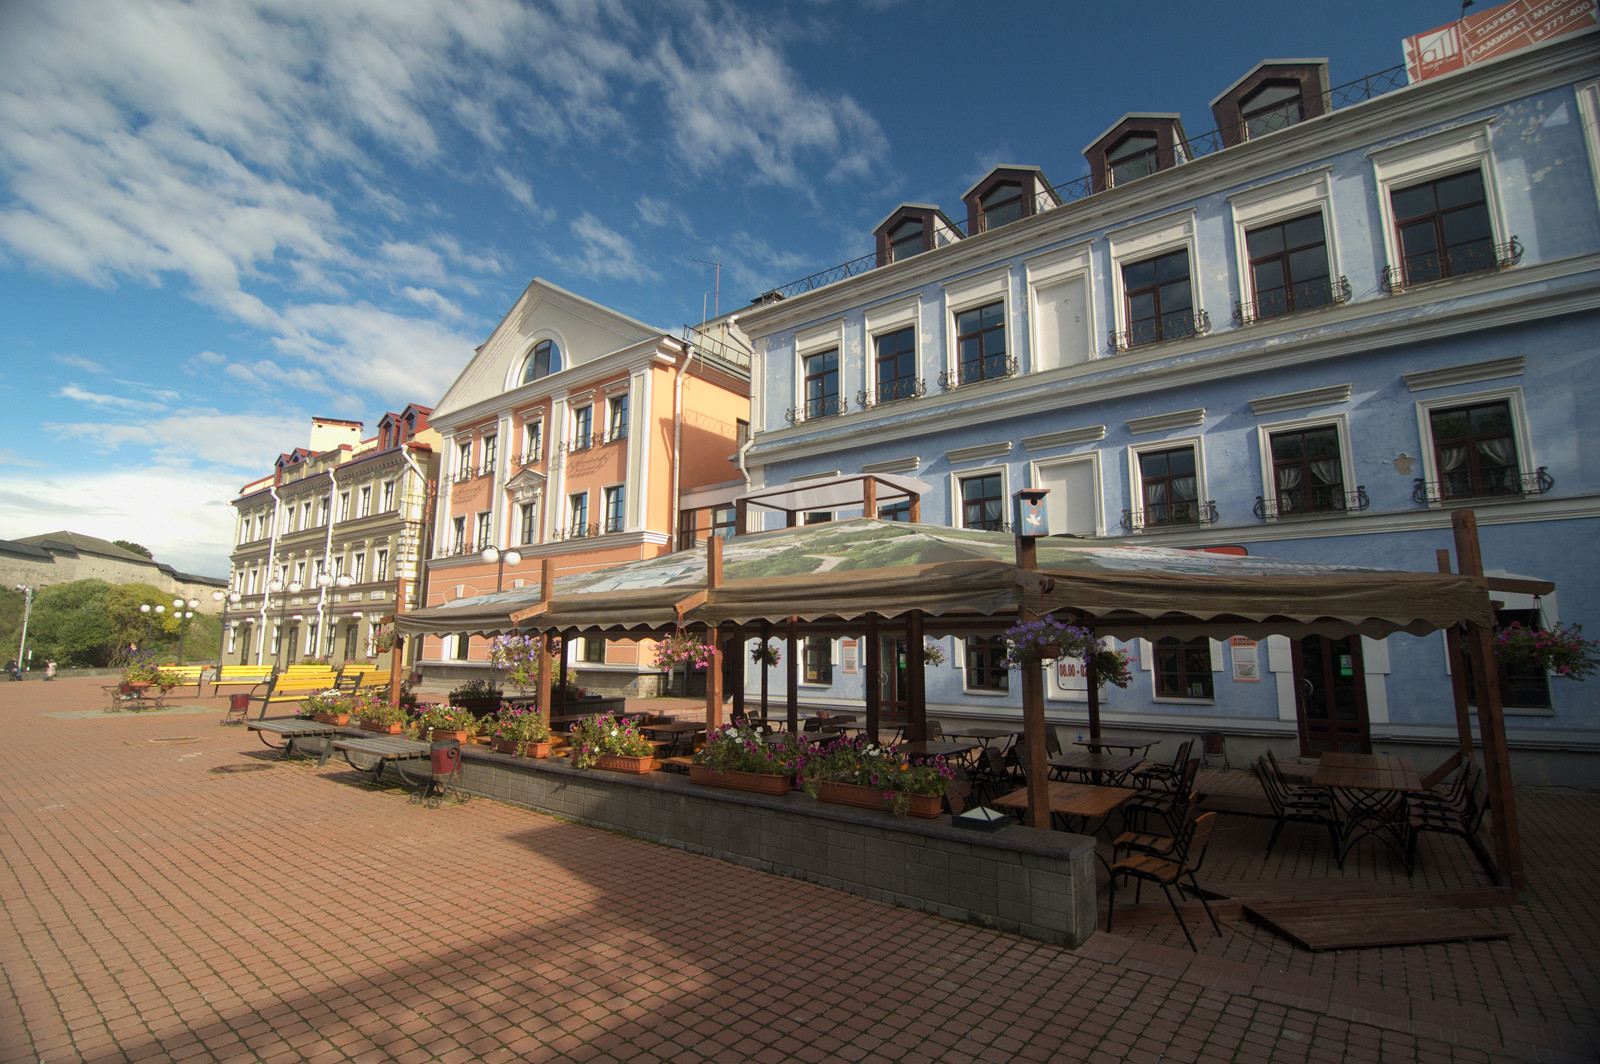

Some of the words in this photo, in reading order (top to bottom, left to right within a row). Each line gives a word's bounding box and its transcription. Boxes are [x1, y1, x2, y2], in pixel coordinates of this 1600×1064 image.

[1476, 8, 1519, 37] ПАРКЕТ
[1544, 1, 1590, 31] 777-400
[1471, 20, 1528, 58] ЛАМИНАТ
[425, 479, 437, 523] HOTEL
[1059, 663, 1075, 677] 08.00
